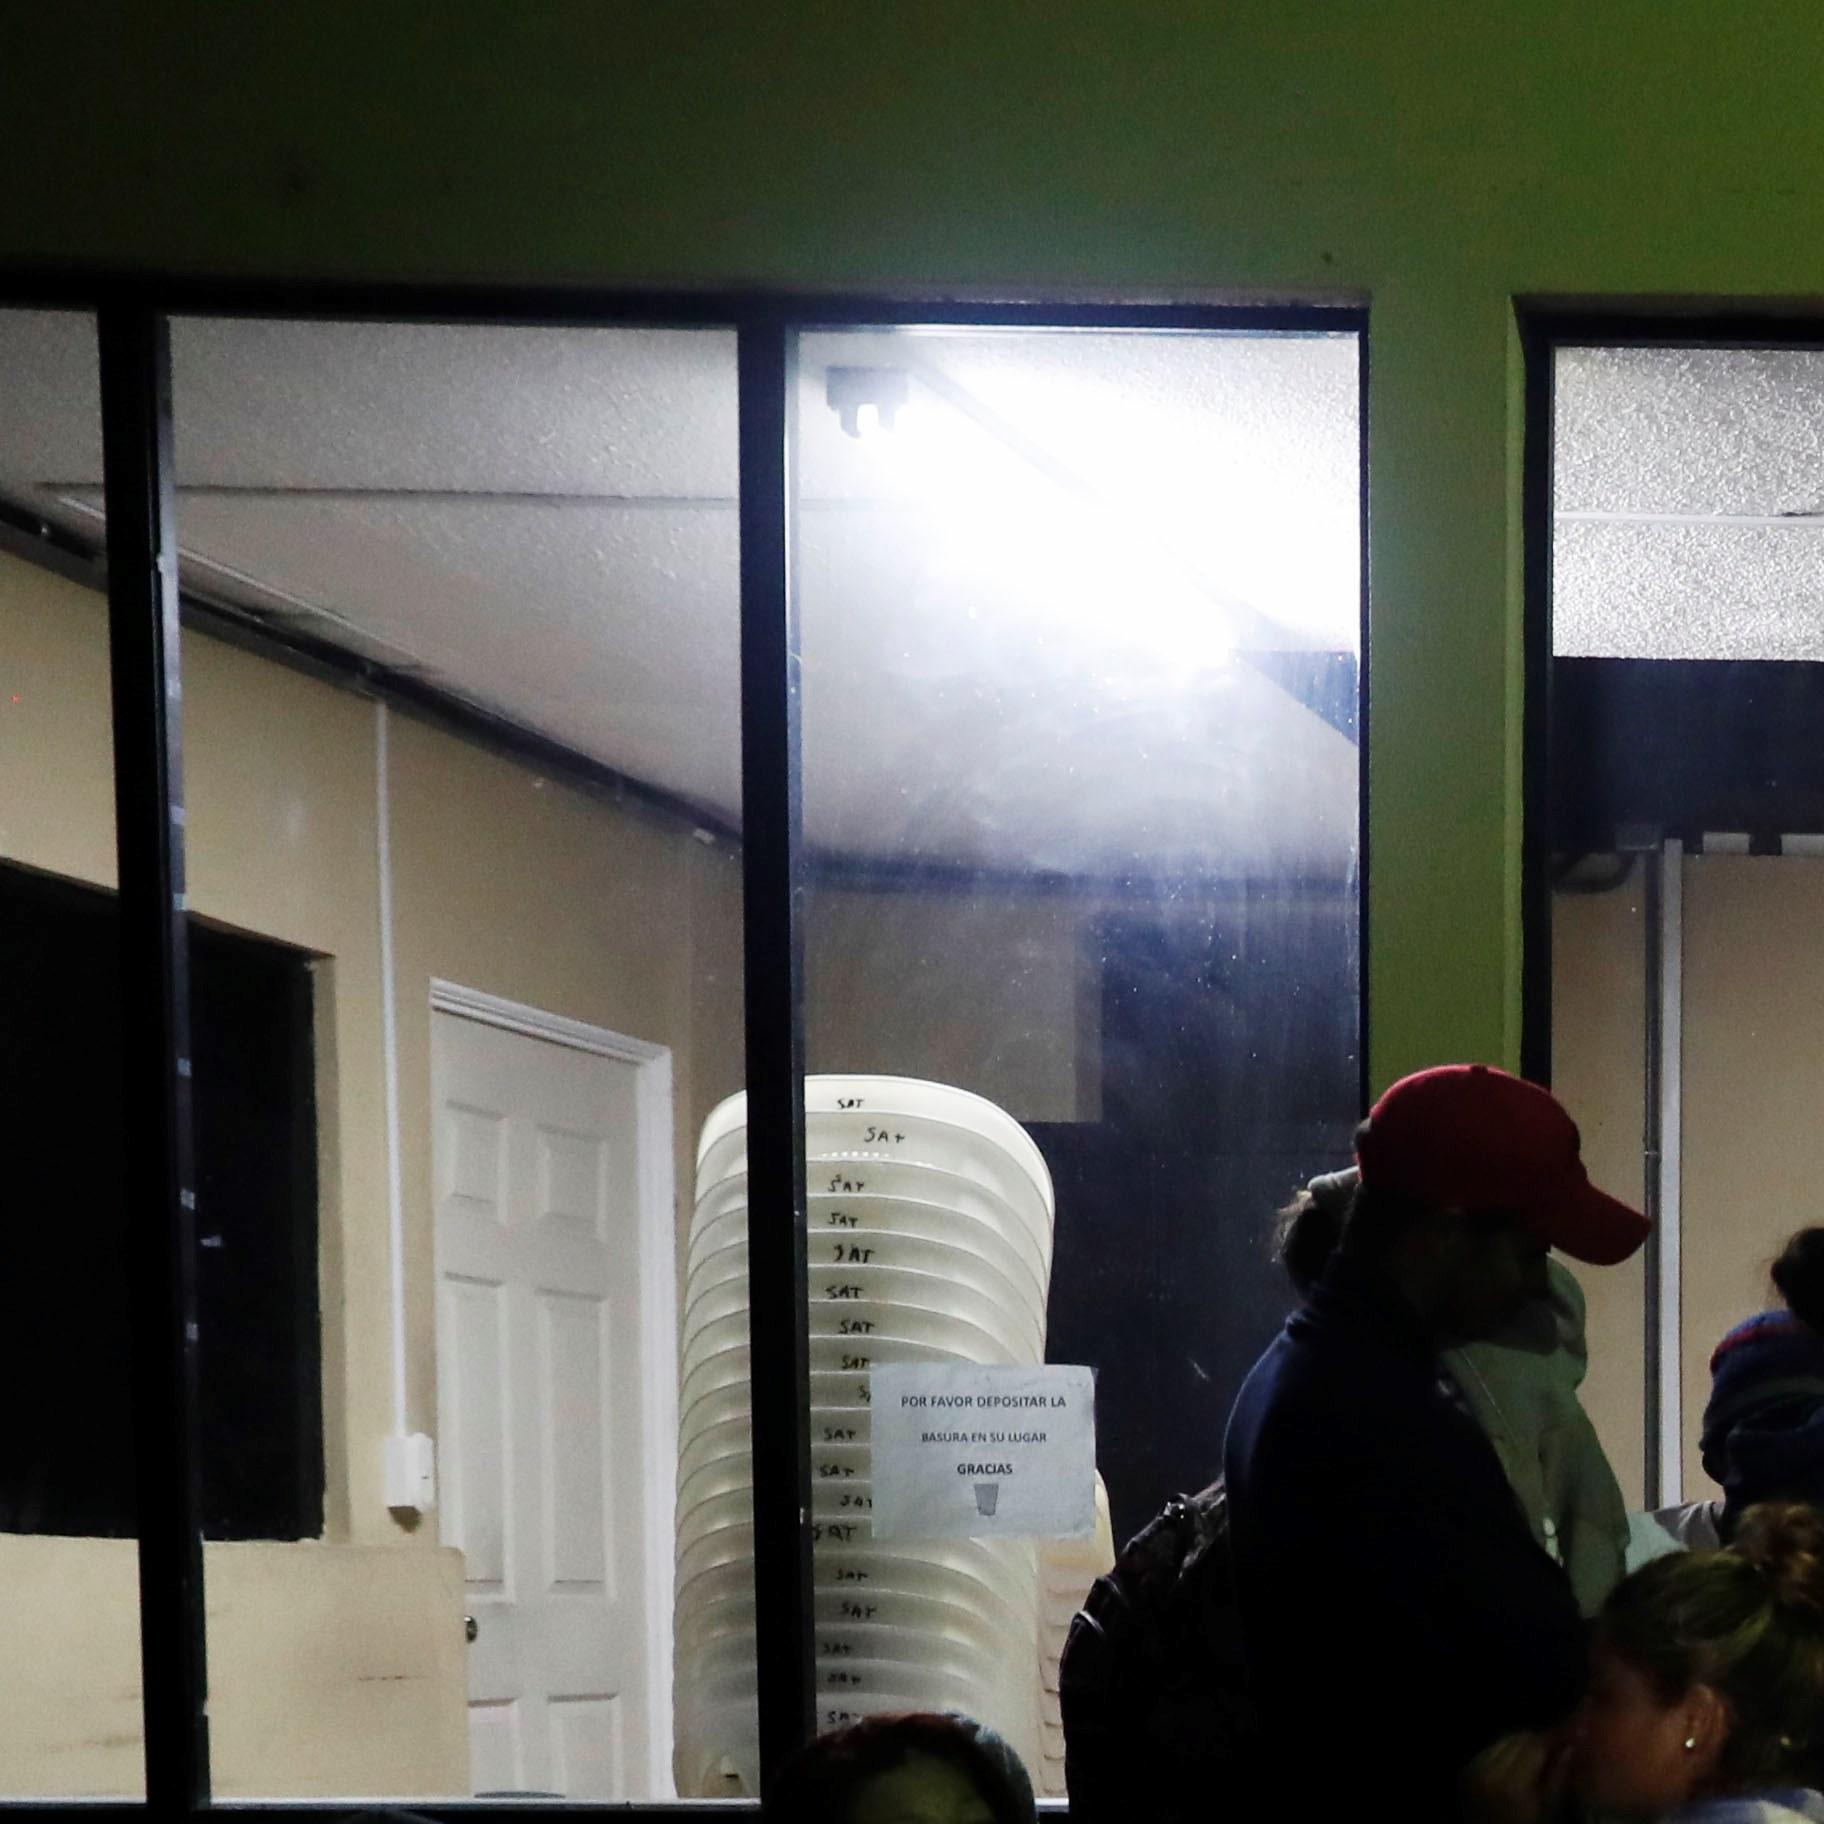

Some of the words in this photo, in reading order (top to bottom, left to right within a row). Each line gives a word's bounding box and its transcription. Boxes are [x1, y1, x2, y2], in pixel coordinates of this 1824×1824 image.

[901, 1396, 927, 1408] POR
[931, 1396, 973, 1408] FAVOR
[977, 1396, 1047, 1408] DEPOSITAR
[1051, 1396, 1066, 1408] LA
[922, 1432, 968, 1443] BASURA
[971, 1432, 986, 1442] EN
[990, 1432, 1005, 1442] SU
[1008, 1432, 1047, 1442] LUGAR
[957, 1464, 1013, 1475] GRACIAS
